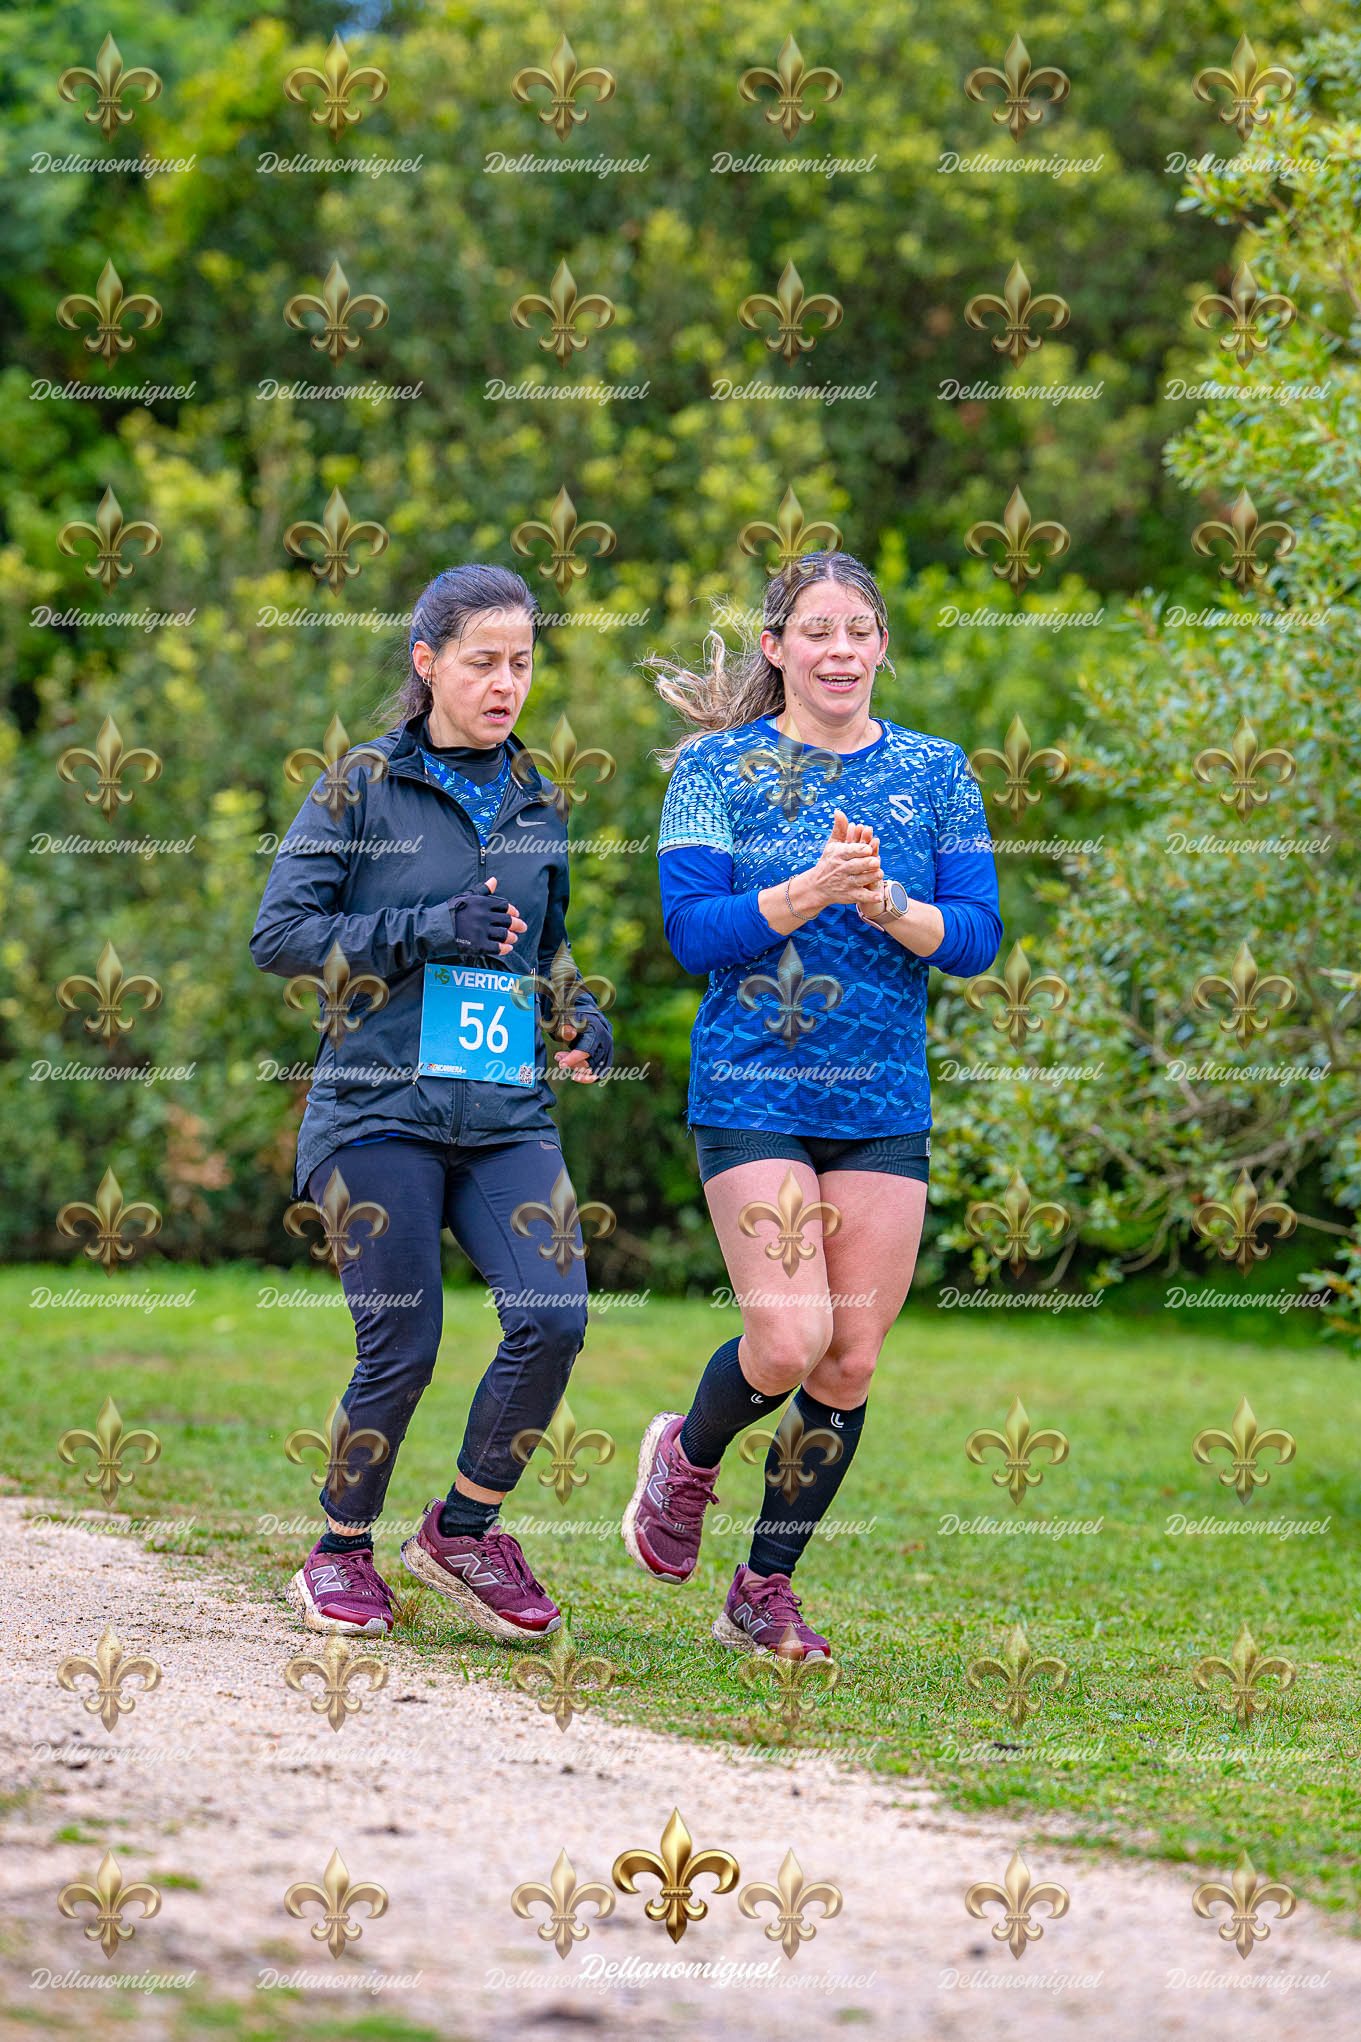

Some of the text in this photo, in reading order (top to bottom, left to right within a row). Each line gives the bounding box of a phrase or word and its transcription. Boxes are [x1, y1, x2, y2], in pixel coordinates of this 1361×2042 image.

[451, 969, 524, 994] VERTICAL
[458, 1001, 509, 1054] 56
[309, 1564, 344, 1597] N
[444, 1552, 500, 1587] N
[733, 1601, 768, 1638] N
